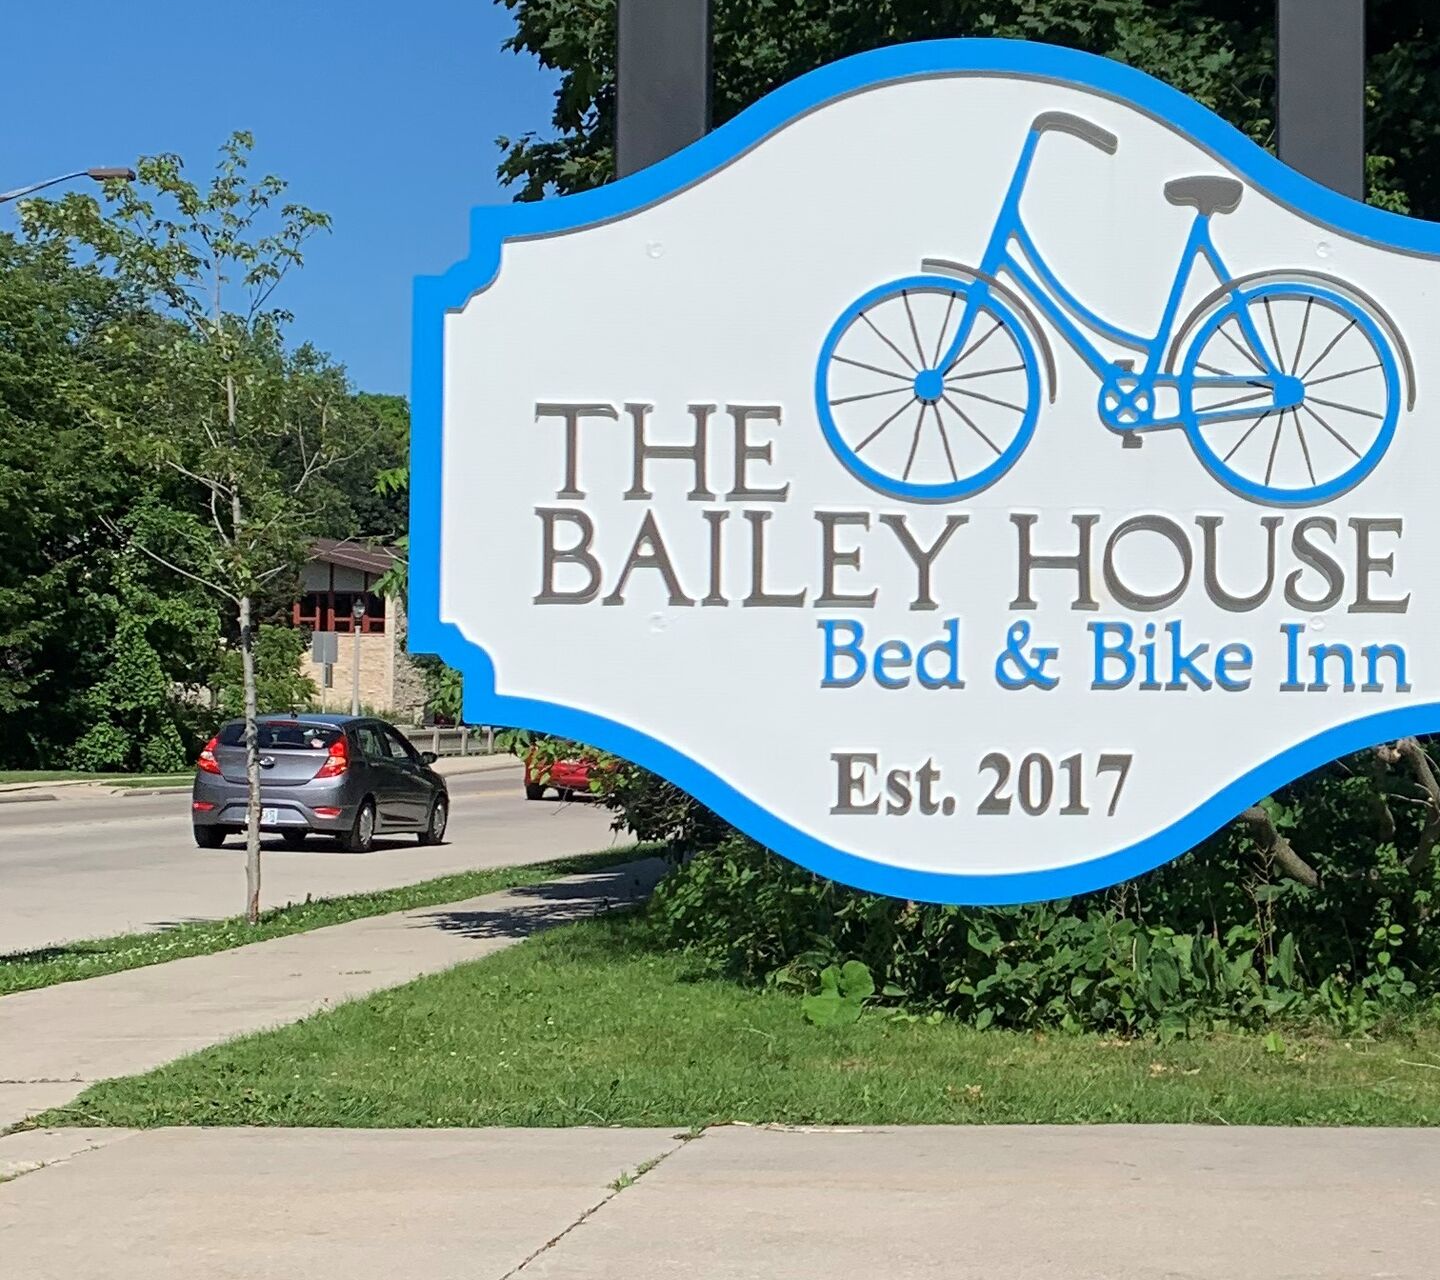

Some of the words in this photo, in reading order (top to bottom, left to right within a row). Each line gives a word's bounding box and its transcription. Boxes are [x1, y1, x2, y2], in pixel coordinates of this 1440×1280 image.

[534, 403, 790, 502] THE
[533, 506, 970, 611] BAILEY
[1010, 514, 1413, 614] HOUSE
[817, 618, 966, 689] Bed
[995, 620, 1061, 690] &
[1088, 621, 1254, 692] Bike
[1279, 623, 1413, 694] Inn
[829, 752, 956, 816] Est.
[977, 753, 1133, 817] 2017
